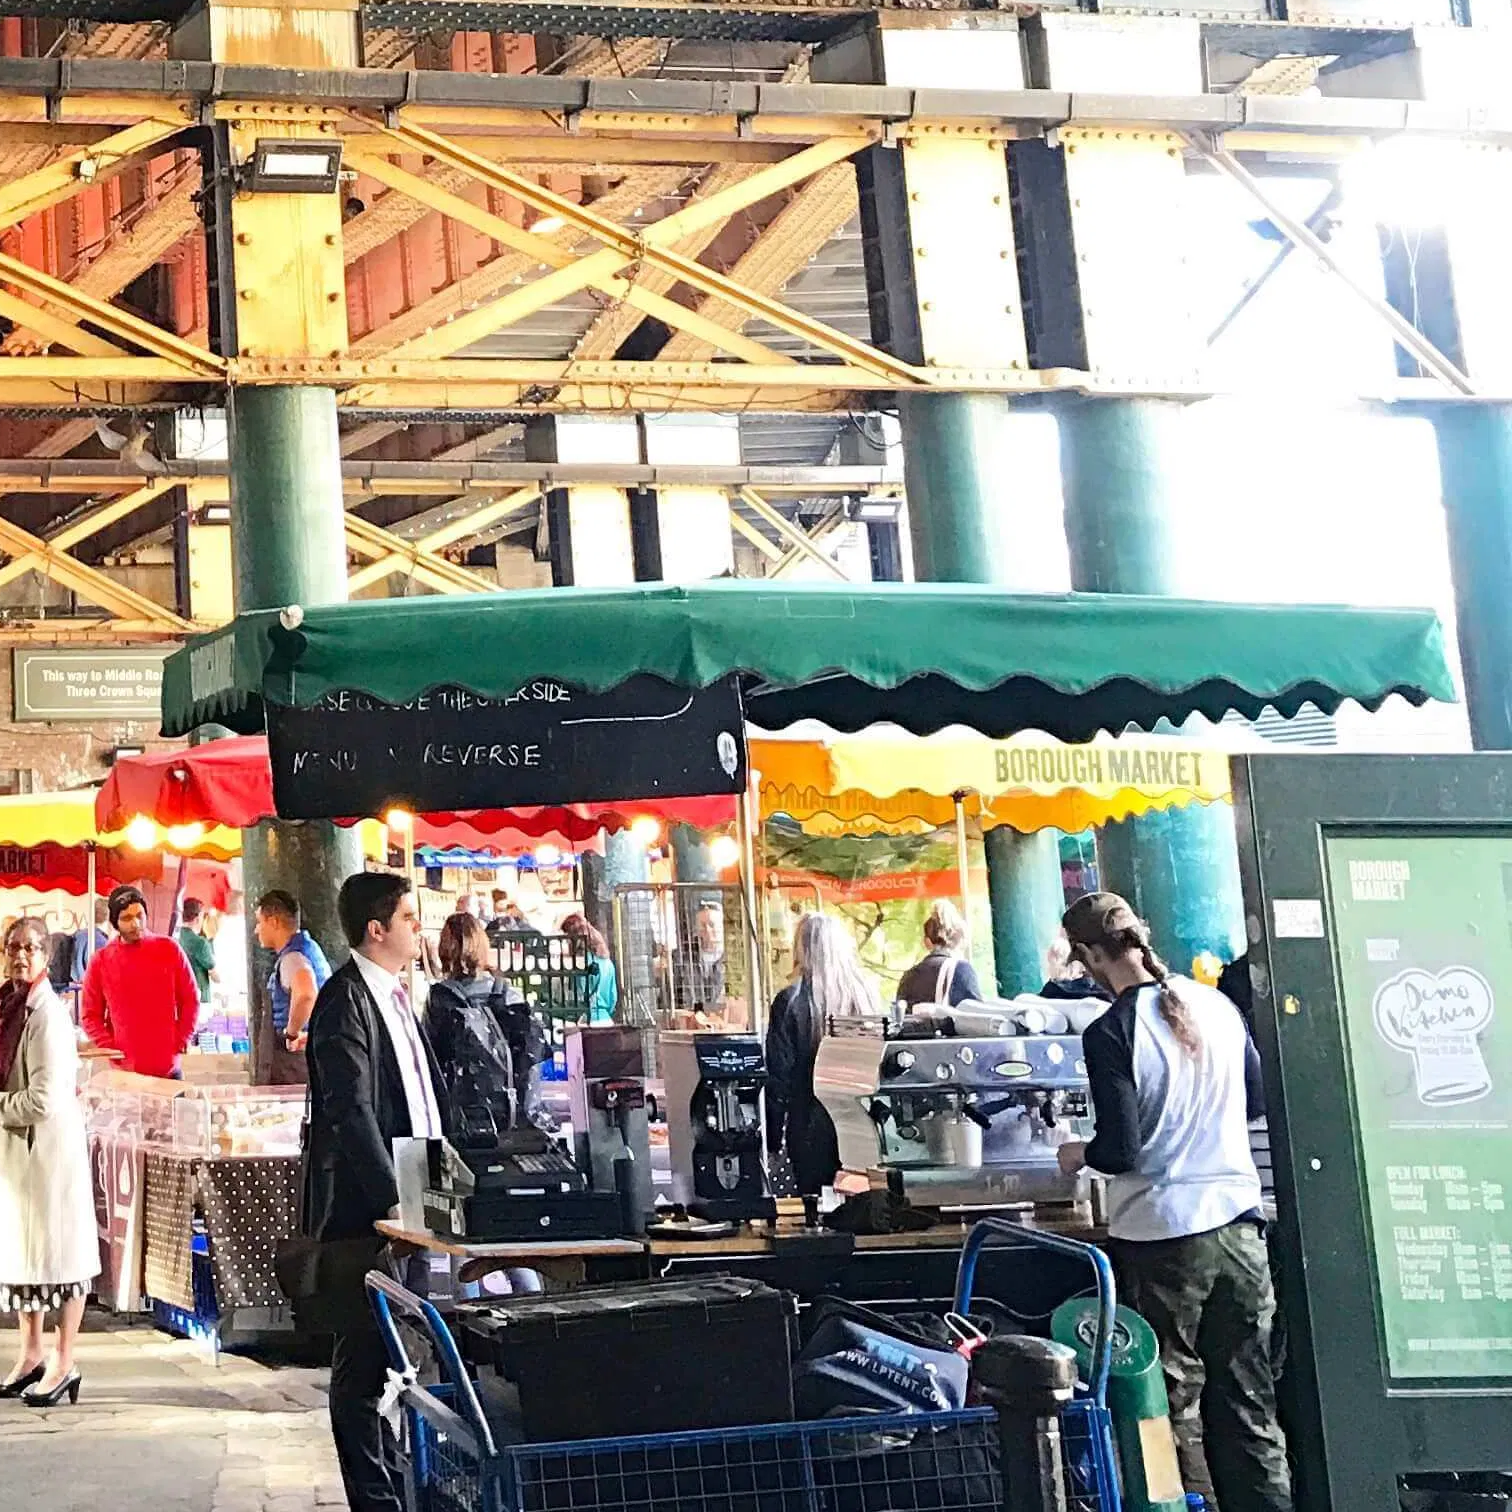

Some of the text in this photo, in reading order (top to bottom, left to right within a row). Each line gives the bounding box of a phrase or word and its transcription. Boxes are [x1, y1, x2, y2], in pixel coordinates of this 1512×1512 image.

[42, 669, 65, 682] This
[67, 671, 89, 684] way
[91, 669, 103, 682] to
[105, 669, 142, 681] Middle
[65, 684, 97, 697] Three
[99, 685, 134, 697] Crown
[532, 681, 571, 703] SIDE
[423, 743, 541, 767] REVERSE
[995, 748, 1203, 786] BOROUGH MARKET
[1348, 860, 1411, 881] BOROUGH
[1405, 981, 1470, 1011] Demo
[1386, 1005, 1476, 1038] Kitchen
[840, 1349, 943, 1405] WW.LPTENT.CO
